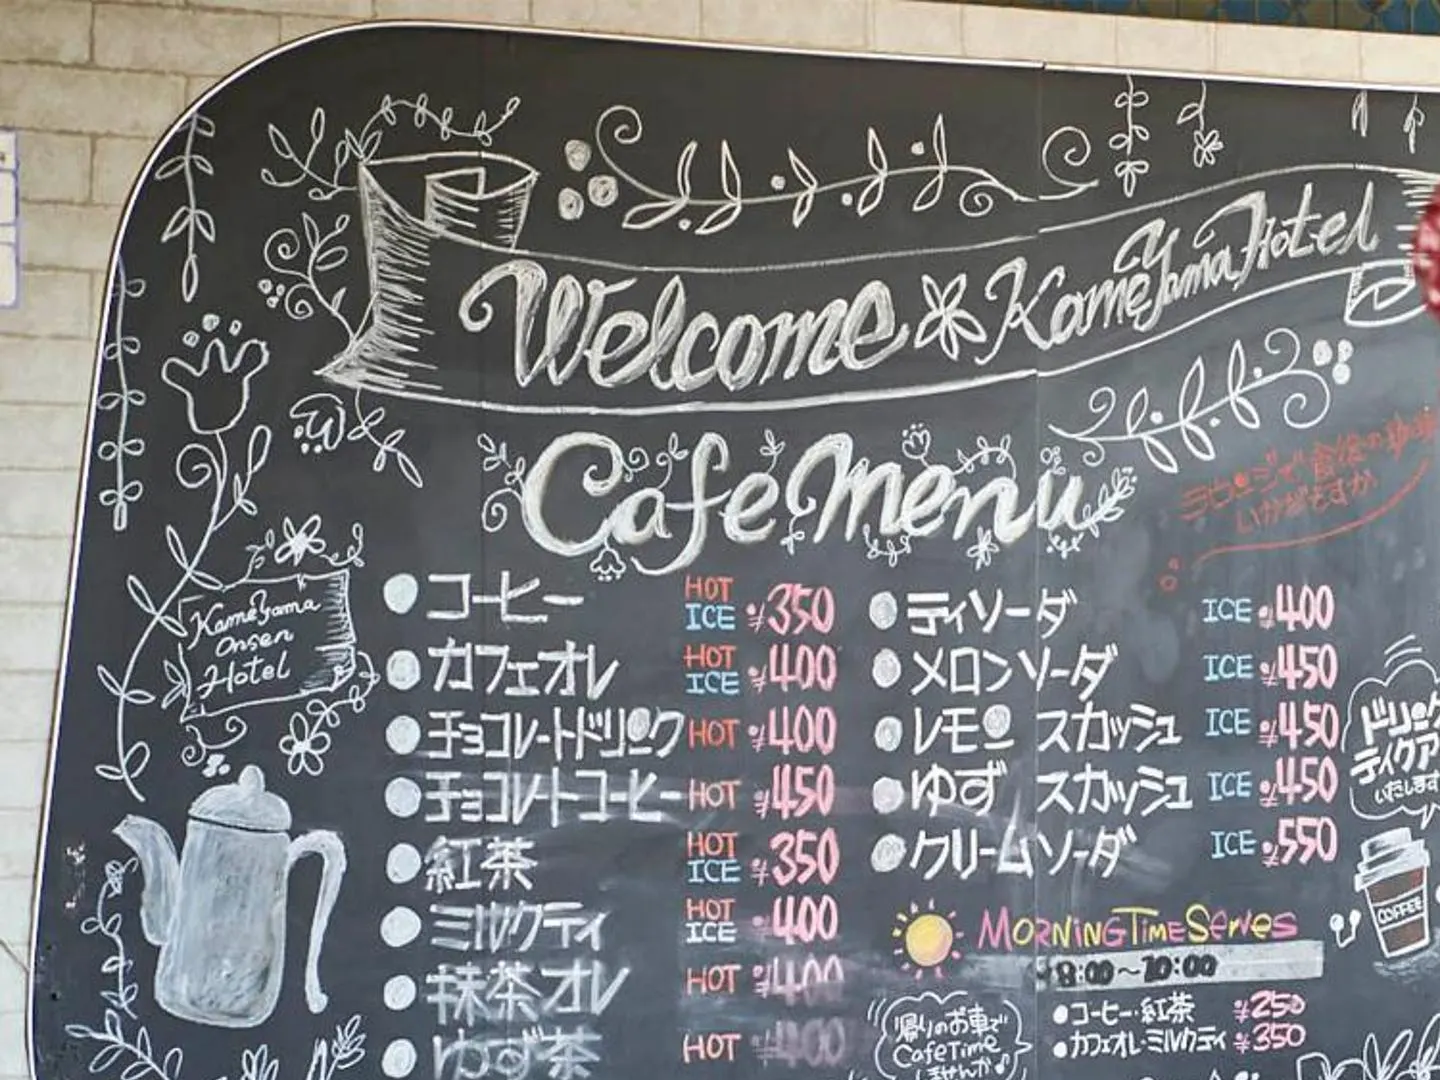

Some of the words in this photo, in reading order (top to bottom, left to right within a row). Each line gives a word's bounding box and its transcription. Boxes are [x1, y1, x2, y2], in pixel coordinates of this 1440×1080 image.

[459, 259, 908, 391] Welcome
[1193, 181, 1380, 292] Hotel
[521, 431, 779, 576] Cafe
[785, 432, 1099, 546] Menu
[426, 571, 584, 624] コーヒー
[684, 576, 733, 602] HOT
[684, 602, 736, 632] ICE
[906, 588, 1078, 639] ティソーダ
[1203, 597, 1252, 625] ICE
[215, 628, 294, 657] Onsen
[684, 644, 736, 671] HOT
[197, 650, 290, 700] Hotel
[428, 637, 620, 700] カフェオレ
[684, 671, 740, 695] ICE
[910, 642, 1119, 701] メロンソーダ
[1203, 653, 1254, 683] ICE
[688, 717, 740, 751] HOT
[1036, 701, 1182, 754] スカッシュ
[1204, 707, 1252, 738] ICE
[689, 778, 741, 811] HOT
[910, 758, 1009, 818] ゆず
[1036, 763, 1194, 817] スカッシュ
[1207, 768, 1252, 802] ICE
[424, 835, 538, 894] 紅茶
[686, 831, 738, 859] HOT
[908, 824, 1138, 881] クリームソーダ
[1209, 829, 1258, 860] ICE
[686, 858, 741, 884] ICE
[428, 901, 608, 952] ミルクティ
[685, 898, 736, 922] HOT
[1378, 898, 1423, 924] COFFEE
[685, 921, 736, 944] ICE
[425, 959, 631, 1026] 抹茶オレ
[685, 964, 741, 996] HOT
[683, 1032, 741, 1062] HOT
